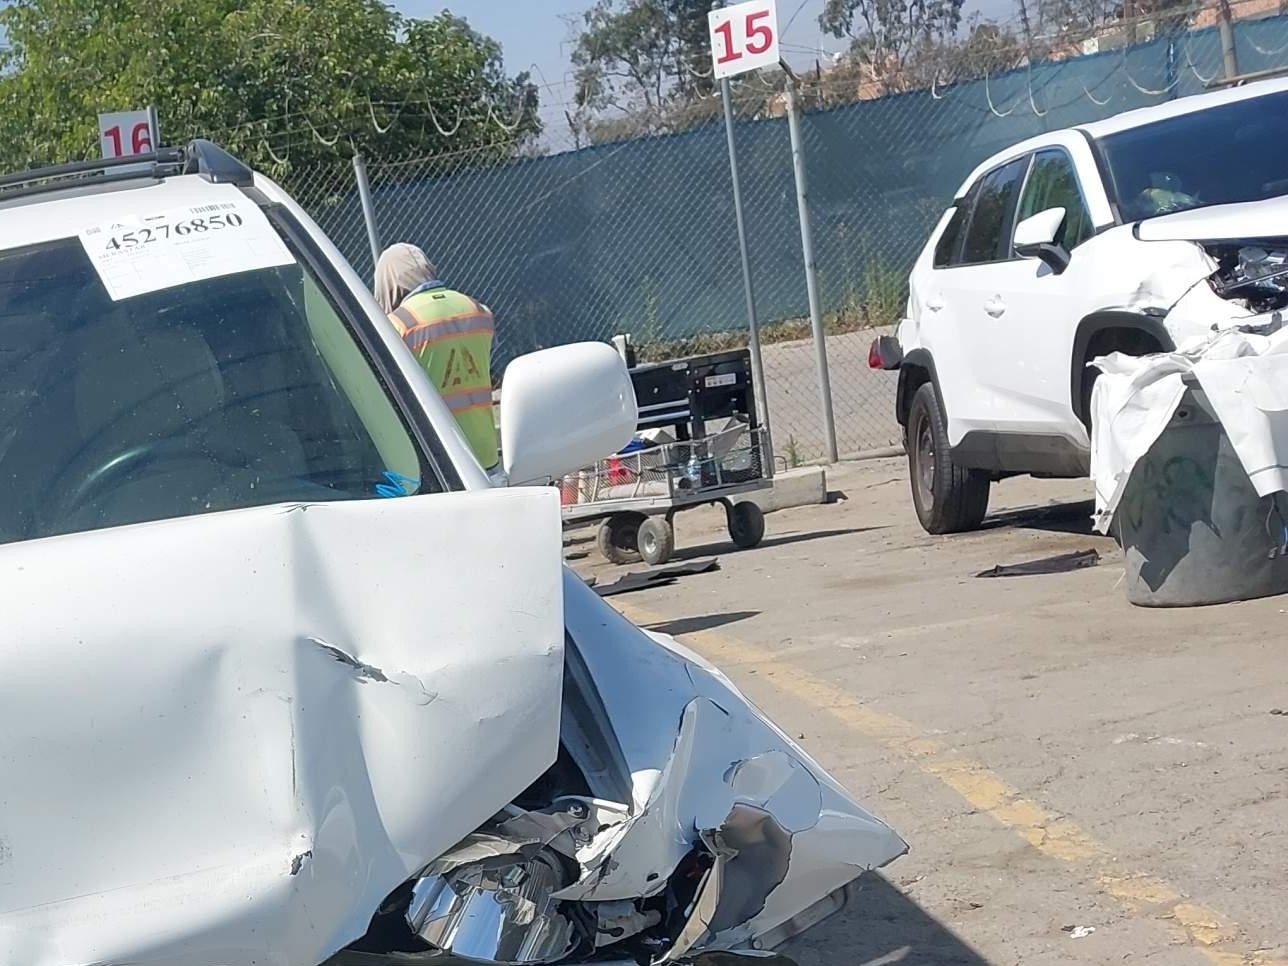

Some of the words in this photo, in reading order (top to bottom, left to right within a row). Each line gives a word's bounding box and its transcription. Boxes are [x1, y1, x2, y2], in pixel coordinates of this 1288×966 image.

[714, 9, 773, 64] 15
[103, 122, 153, 157] 16
[105, 212, 243, 250] 45276850
